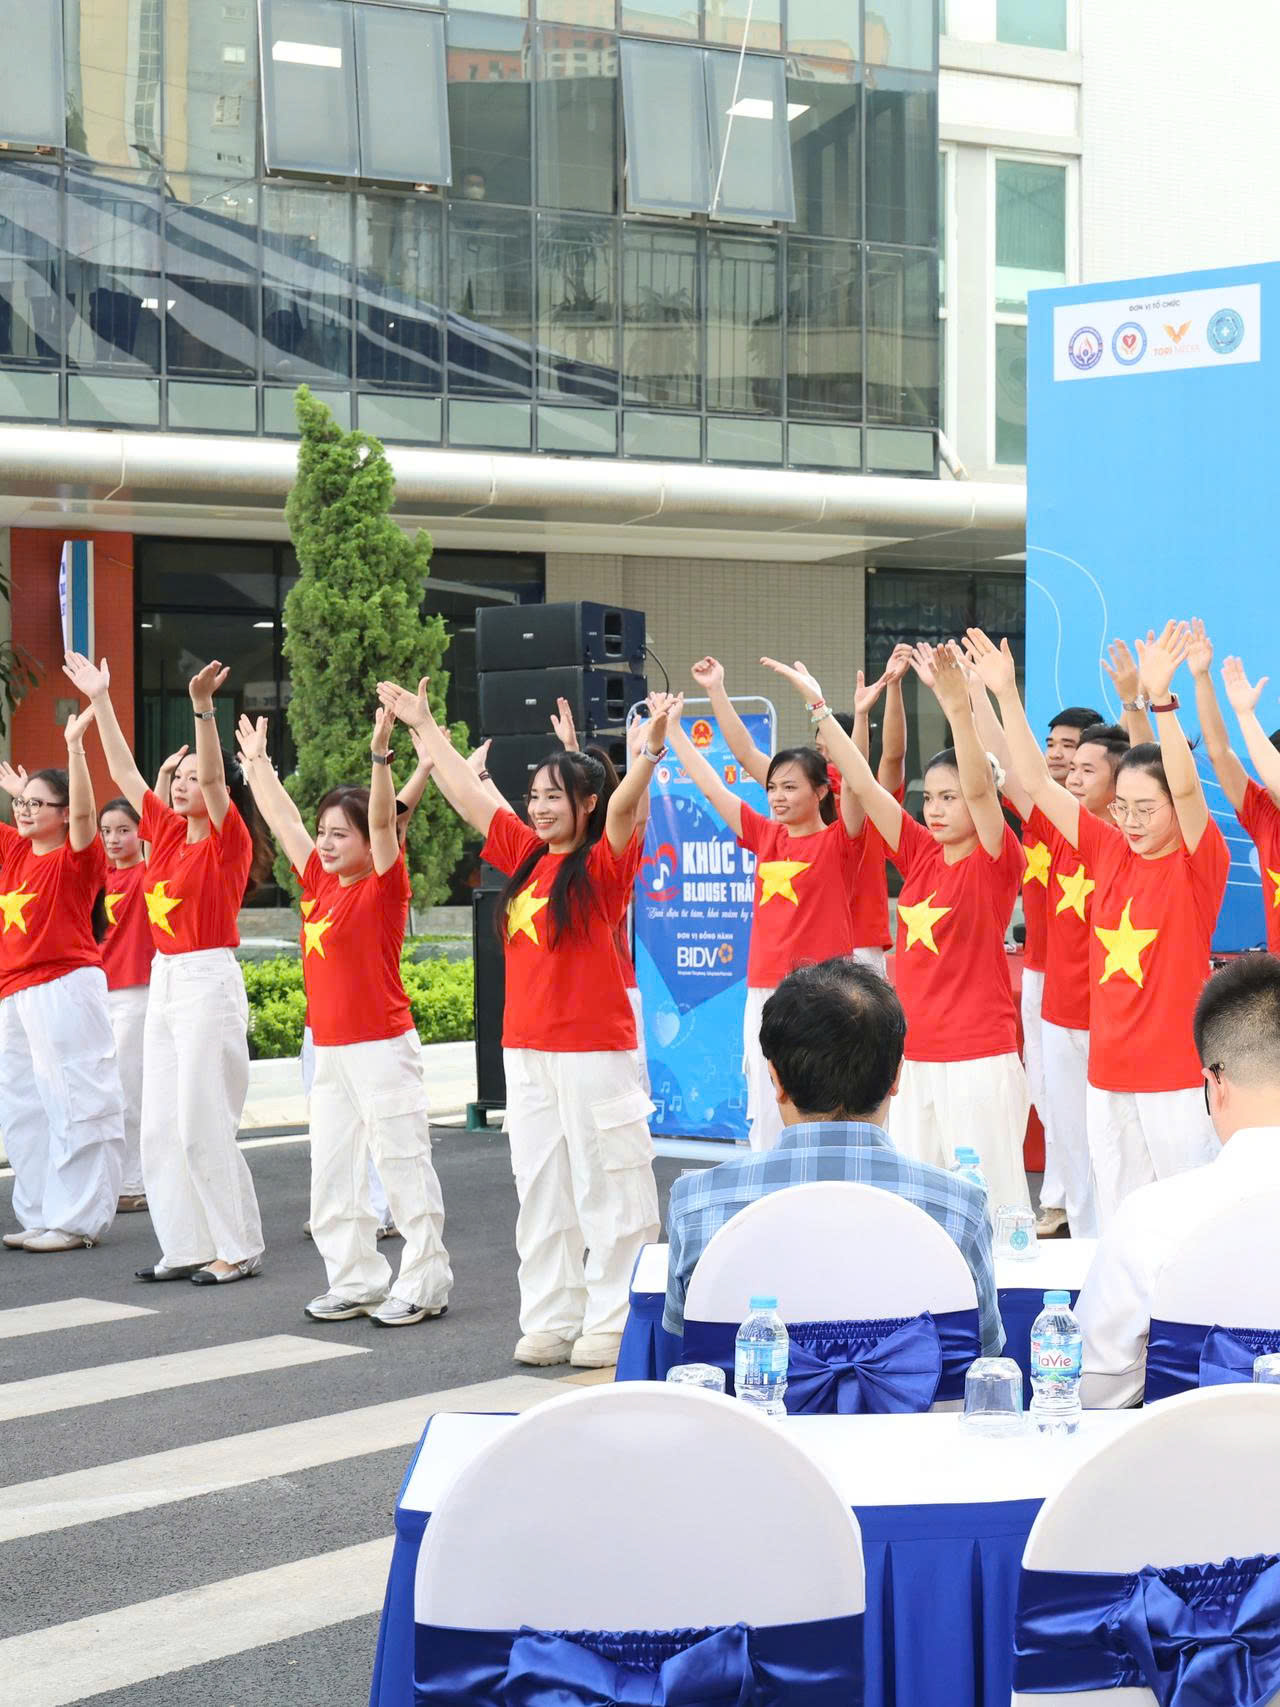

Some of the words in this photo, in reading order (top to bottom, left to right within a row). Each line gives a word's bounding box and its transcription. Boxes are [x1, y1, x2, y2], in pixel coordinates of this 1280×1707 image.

[682, 836, 735, 875] KHÚC
[742, 848, 757, 874] C
[683, 881, 728, 902] BLOUSE
[676, 946, 719, 968] BIDV
